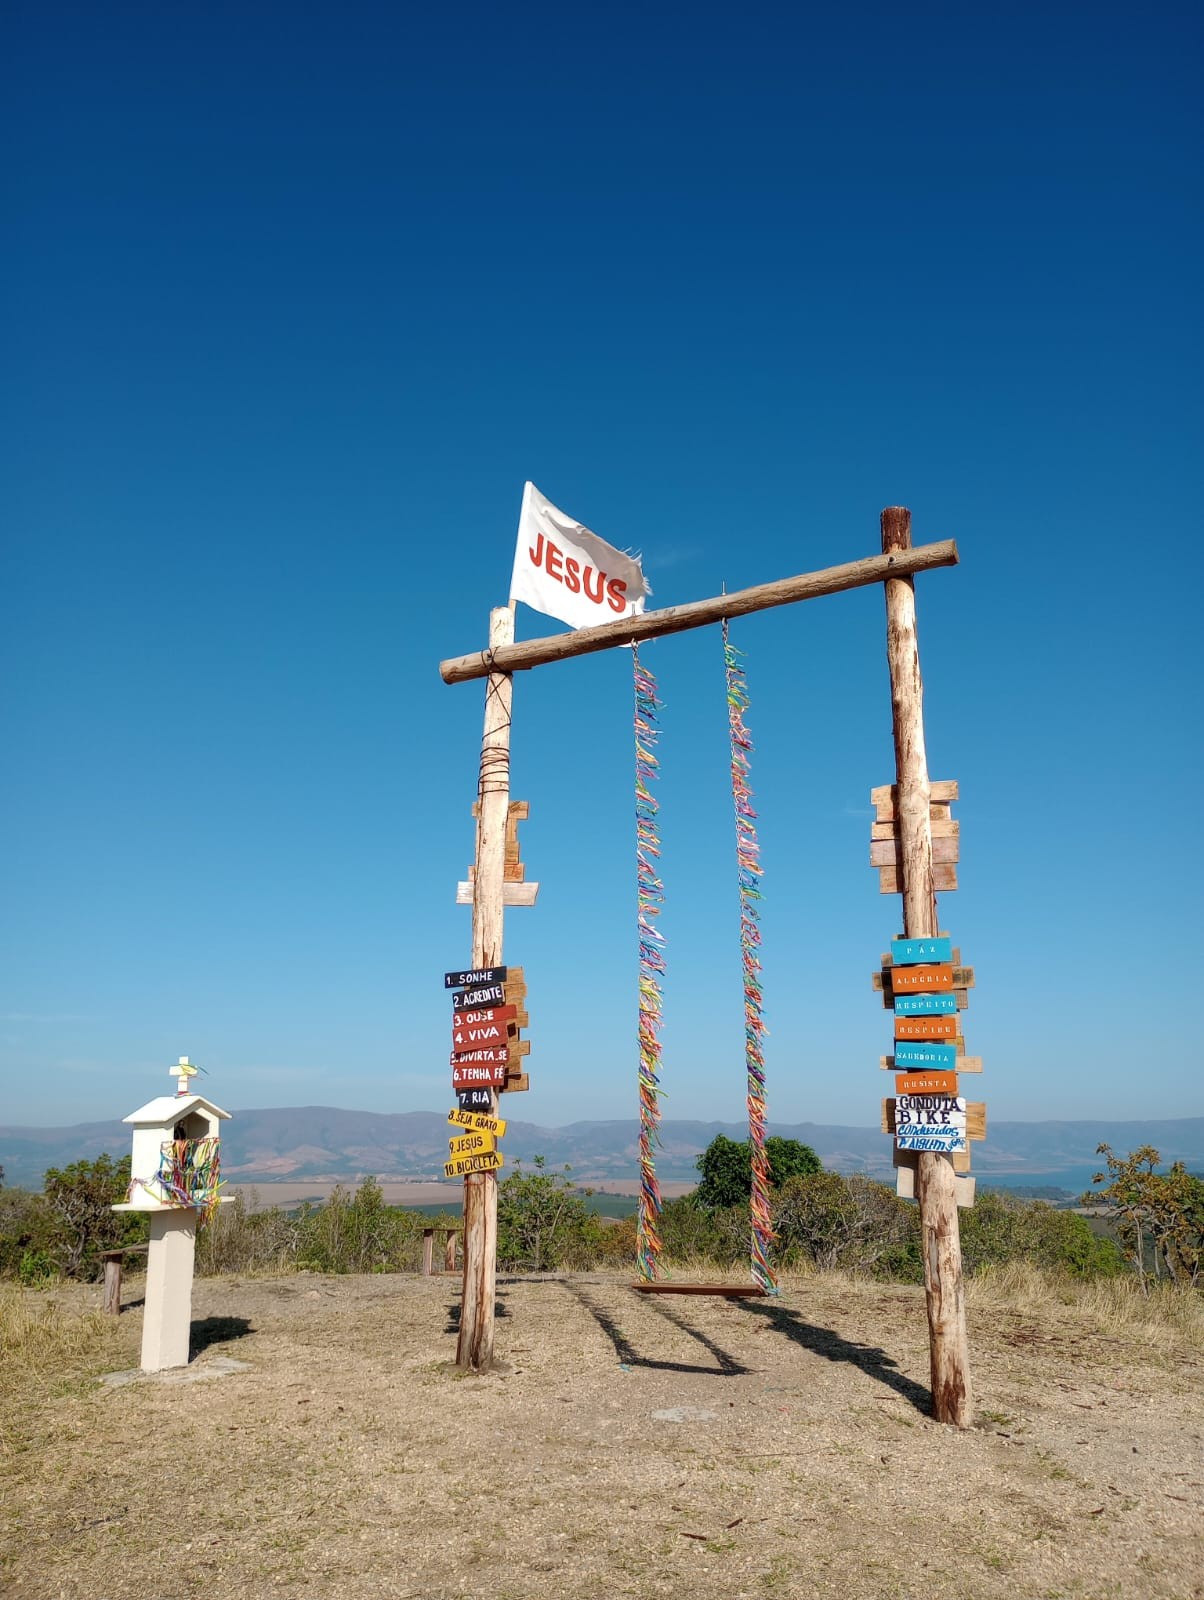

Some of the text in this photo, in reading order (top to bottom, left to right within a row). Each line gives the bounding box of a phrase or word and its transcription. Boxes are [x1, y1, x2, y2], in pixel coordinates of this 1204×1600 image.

[528, 532, 627, 614] JESUS
[459, 972, 493, 984] SONHE
[896, 976, 948, 985] ALEGRIA
[896, 1001, 954, 1010] RESPEITO
[466, 1010, 494, 1024] OUSE
[468, 1026, 500, 1041] VIVA
[899, 1026, 951, 1034] RESPIRE
[896, 1052, 949, 1062] SABEDORIA
[494, 1064, 504, 1079] FÉ
[903, 1080, 947, 1089] RESISTA
[472, 1091, 490, 1104] RIA
[475, 1117, 498, 1131] GRATO
[897, 1110, 951, 1125] BIKE
